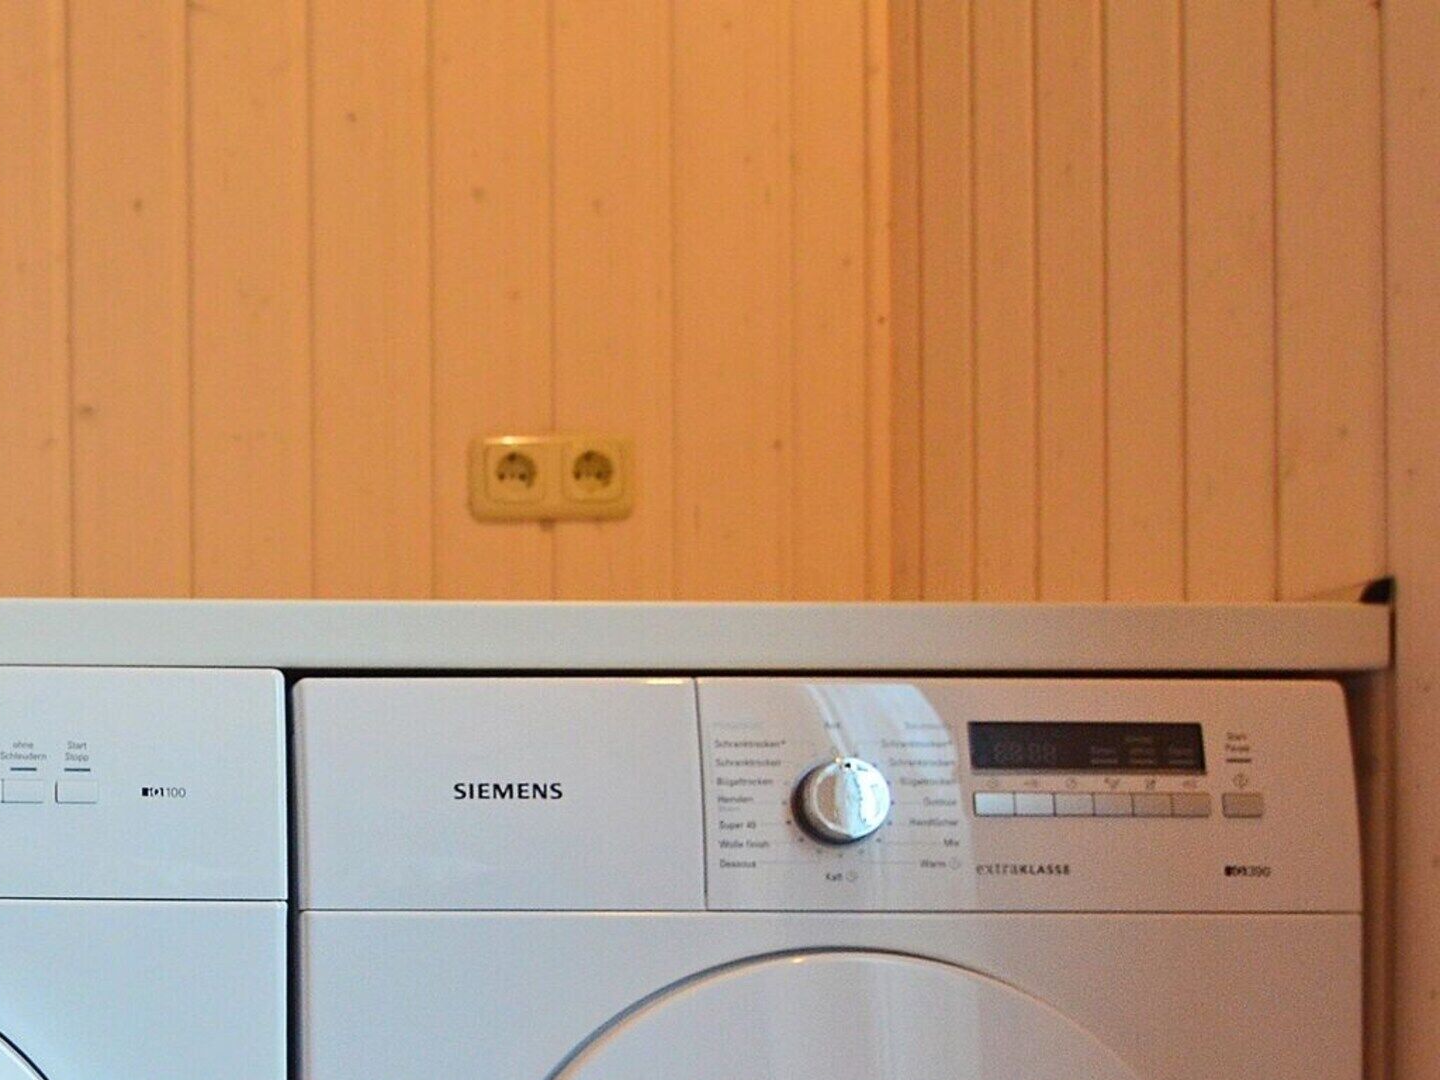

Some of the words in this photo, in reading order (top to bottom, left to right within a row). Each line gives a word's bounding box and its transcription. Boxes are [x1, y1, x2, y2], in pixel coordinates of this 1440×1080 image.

[12, 740, 34, 749] ohne
[67, 741, 87, 750] Start
[0, 751, 47, 761] Schleudern
[64, 752, 89, 762] Stopp
[453, 782, 563, 800] SIEMENS
